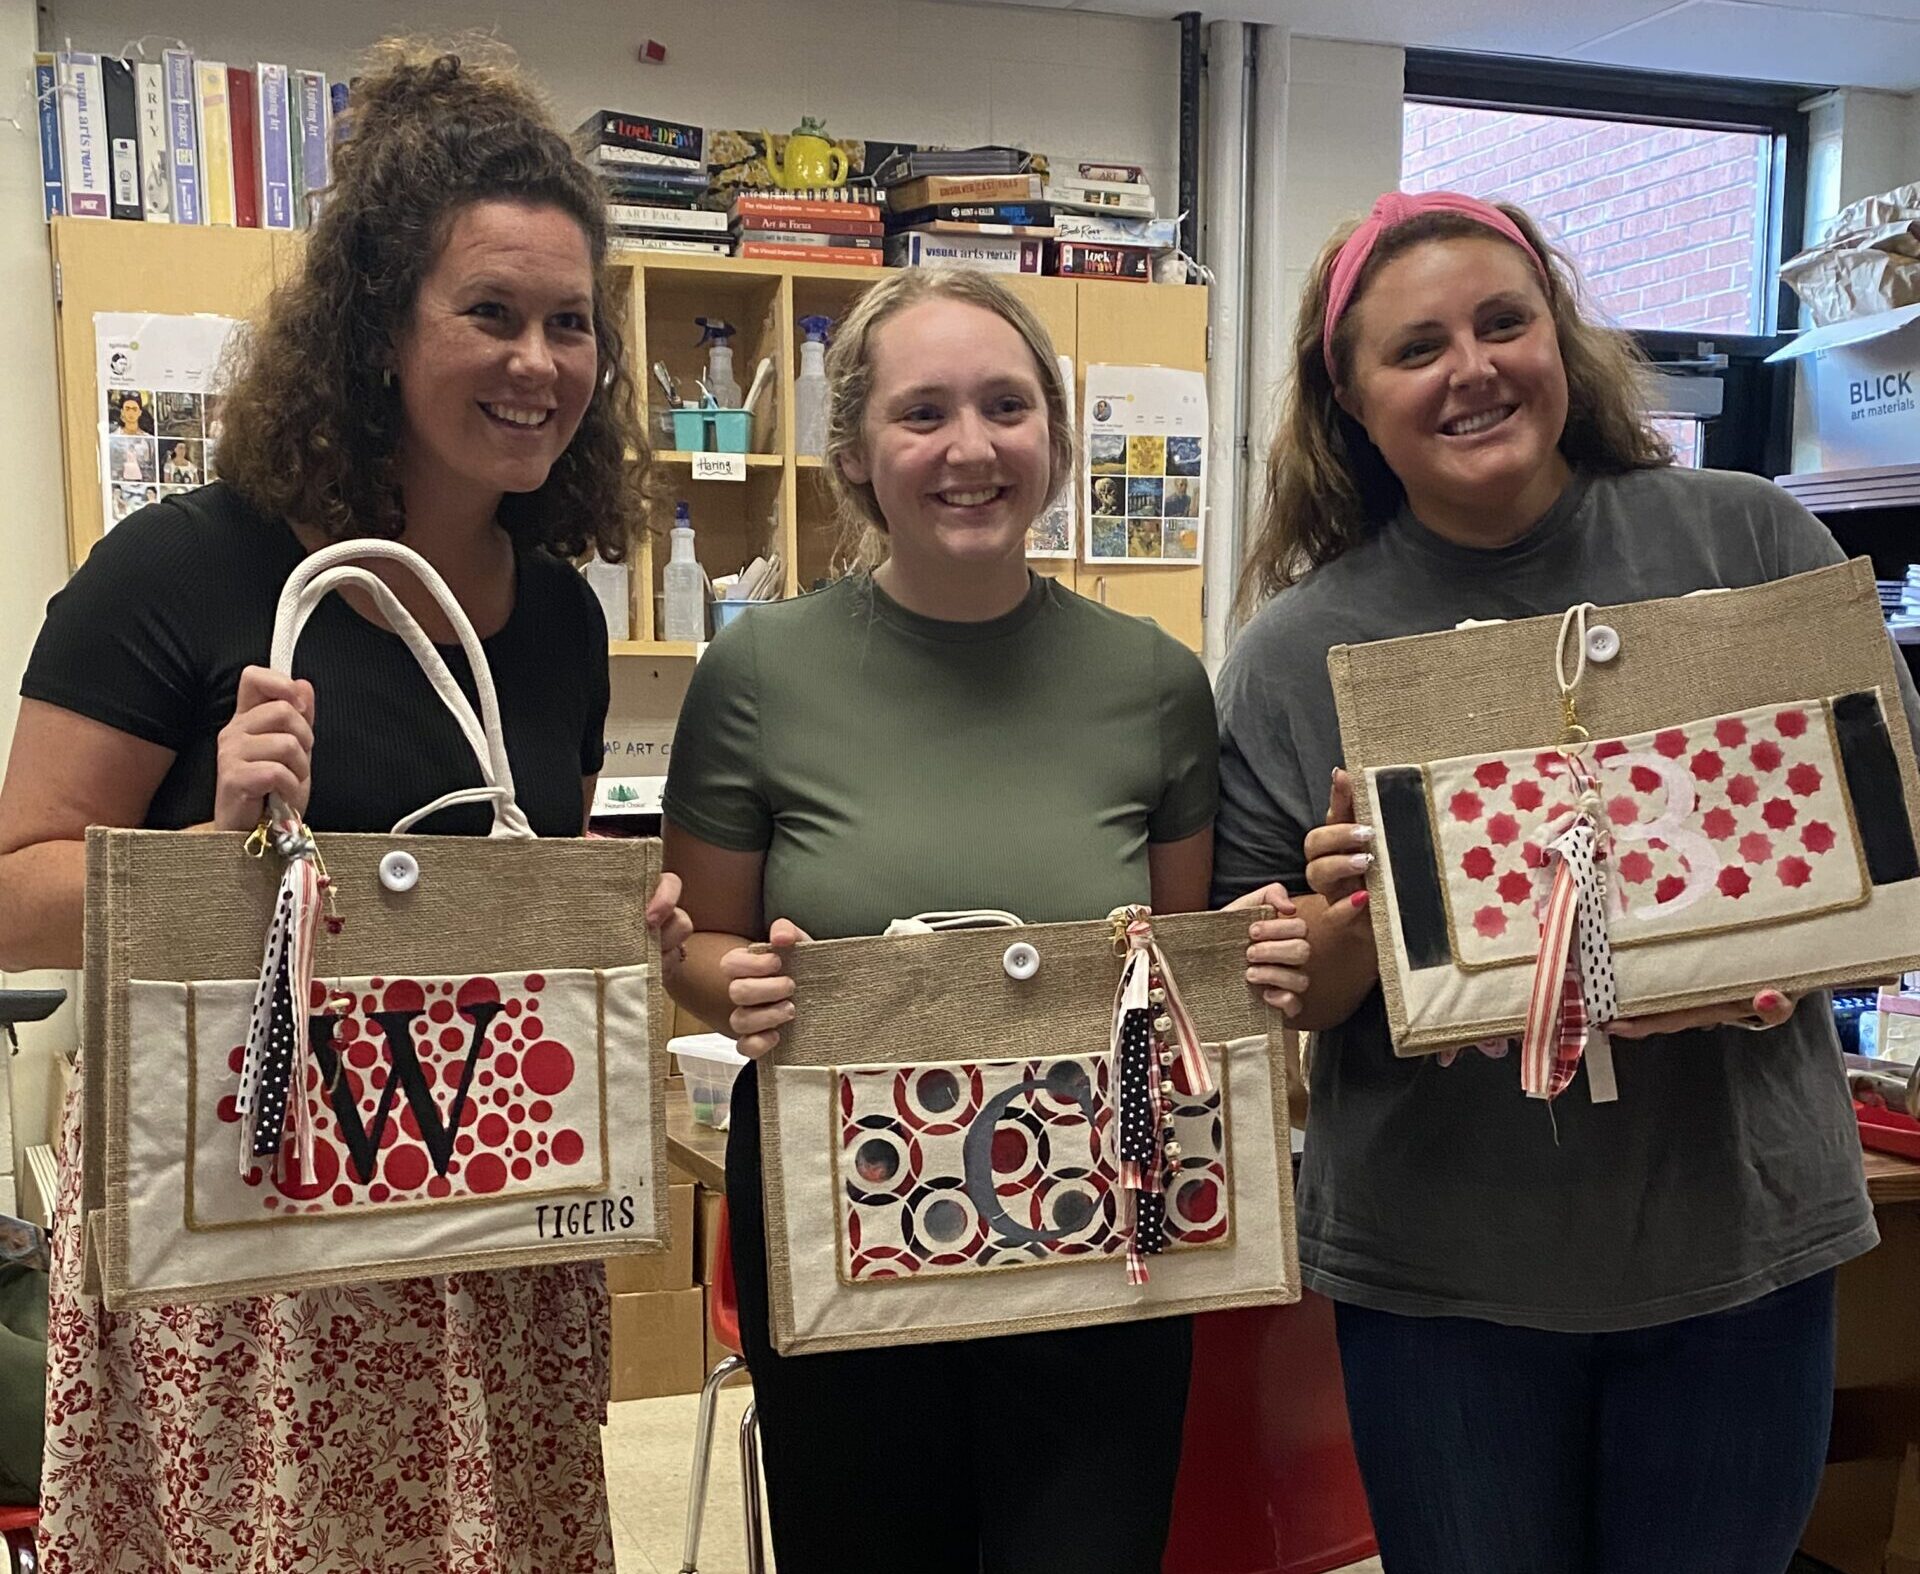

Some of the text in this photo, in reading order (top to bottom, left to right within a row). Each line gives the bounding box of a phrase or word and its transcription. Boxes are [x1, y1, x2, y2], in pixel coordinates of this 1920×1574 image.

[79, 116, 92, 145] arts
[270, 119, 280, 131] Art
[309, 126, 319, 137] Art
[1101, 171, 1118, 180] ART
[626, 207, 648, 219] ART
[652, 208, 681, 221] PACK
[762, 219, 812, 230] Art in Focus
[926, 247, 958, 258] VISUAL
[961, 247, 984, 259] arts
[1849, 370, 1913, 405] BLICK
[1851, 398, 1915, 420] art materials
[696, 456, 732, 474] Haring
[626, 742, 655, 755] ART
[307, 1001, 507, 1186] W
[963, 1064, 1107, 1243] C
[535, 1195, 635, 1239] TIGERS
